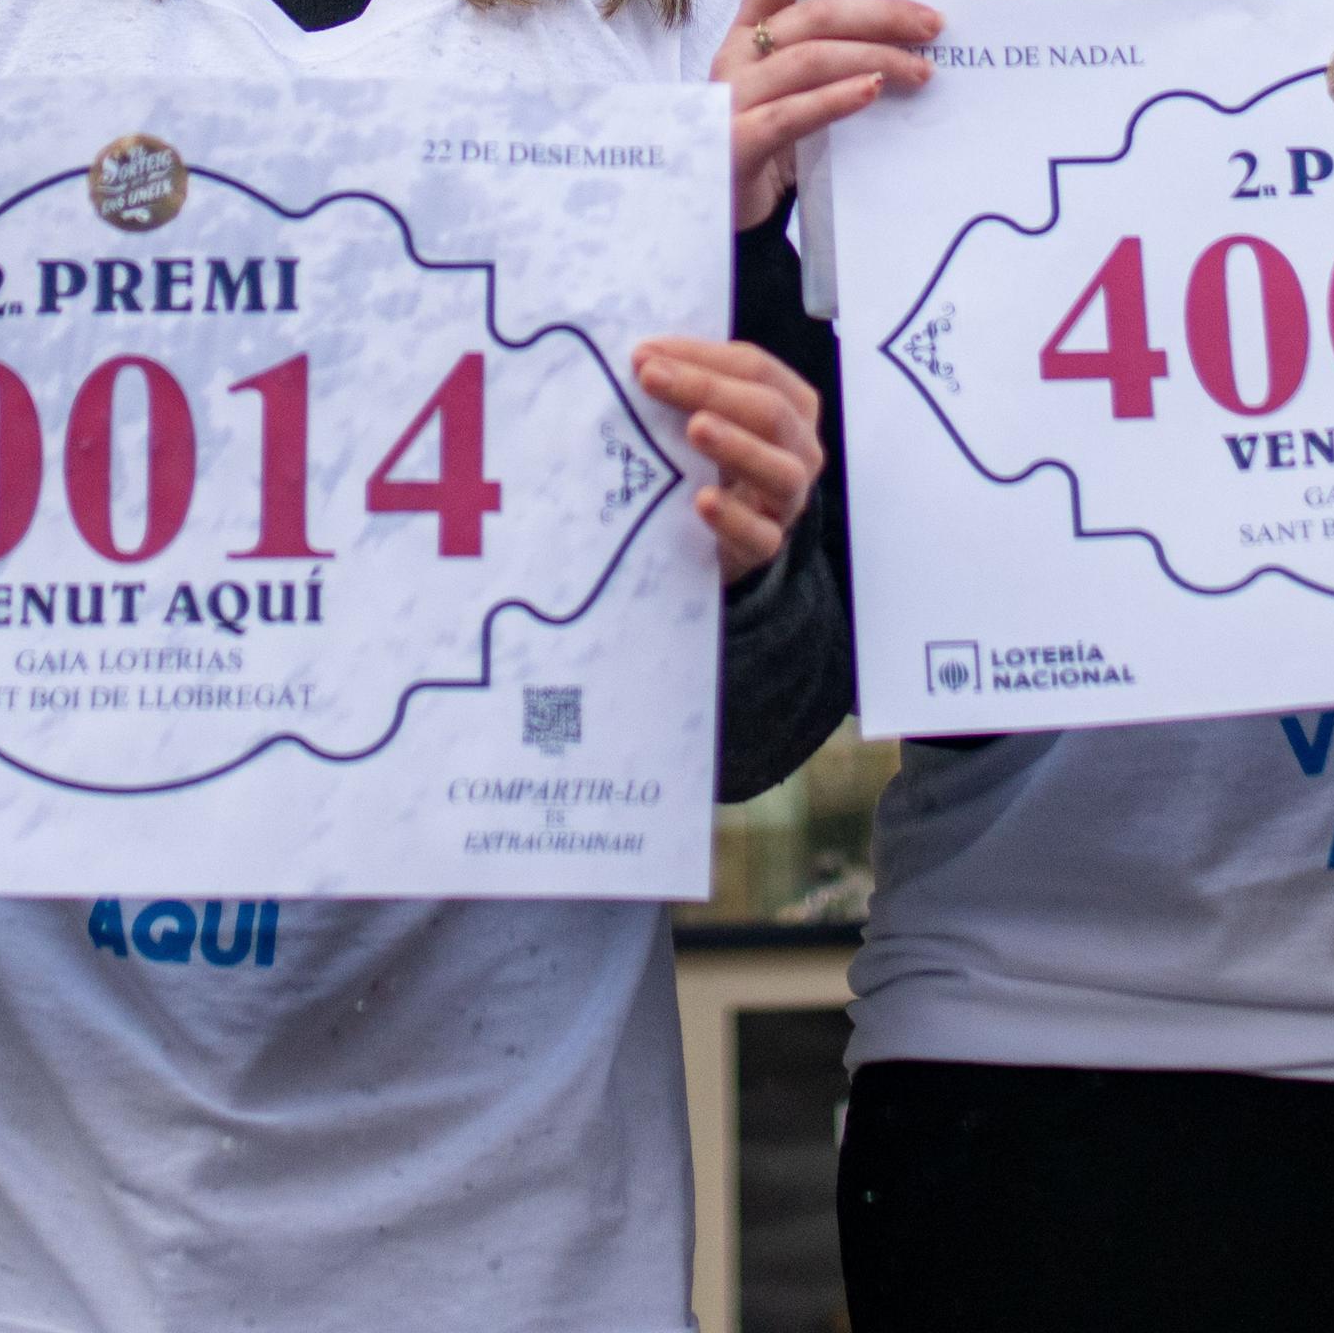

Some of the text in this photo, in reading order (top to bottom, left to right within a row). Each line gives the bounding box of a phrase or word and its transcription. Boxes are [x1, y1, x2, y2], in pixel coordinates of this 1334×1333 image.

[910, 44, 1146, 67] TERIA DE NADAL
[422, 139, 665, 168] 22 DE DESEMBRE
[36, 257, 300, 315] PREMI
[1238, 519, 1314, 547] SANT
[164, 564, 325, 636] AQUÍ
[14, 645, 244, 676] GAIA LOTERIAS
[990, 639, 1104, 668] LOTERÍA
[992, 663, 1136, 691] NACIONAL
[29, 684, 83, 712] BOI
[89, 684, 130, 711] DE
[138, 681, 317, 711] LLOBREGAT
[447, 777, 662, 806] COMPARTIR-LO
